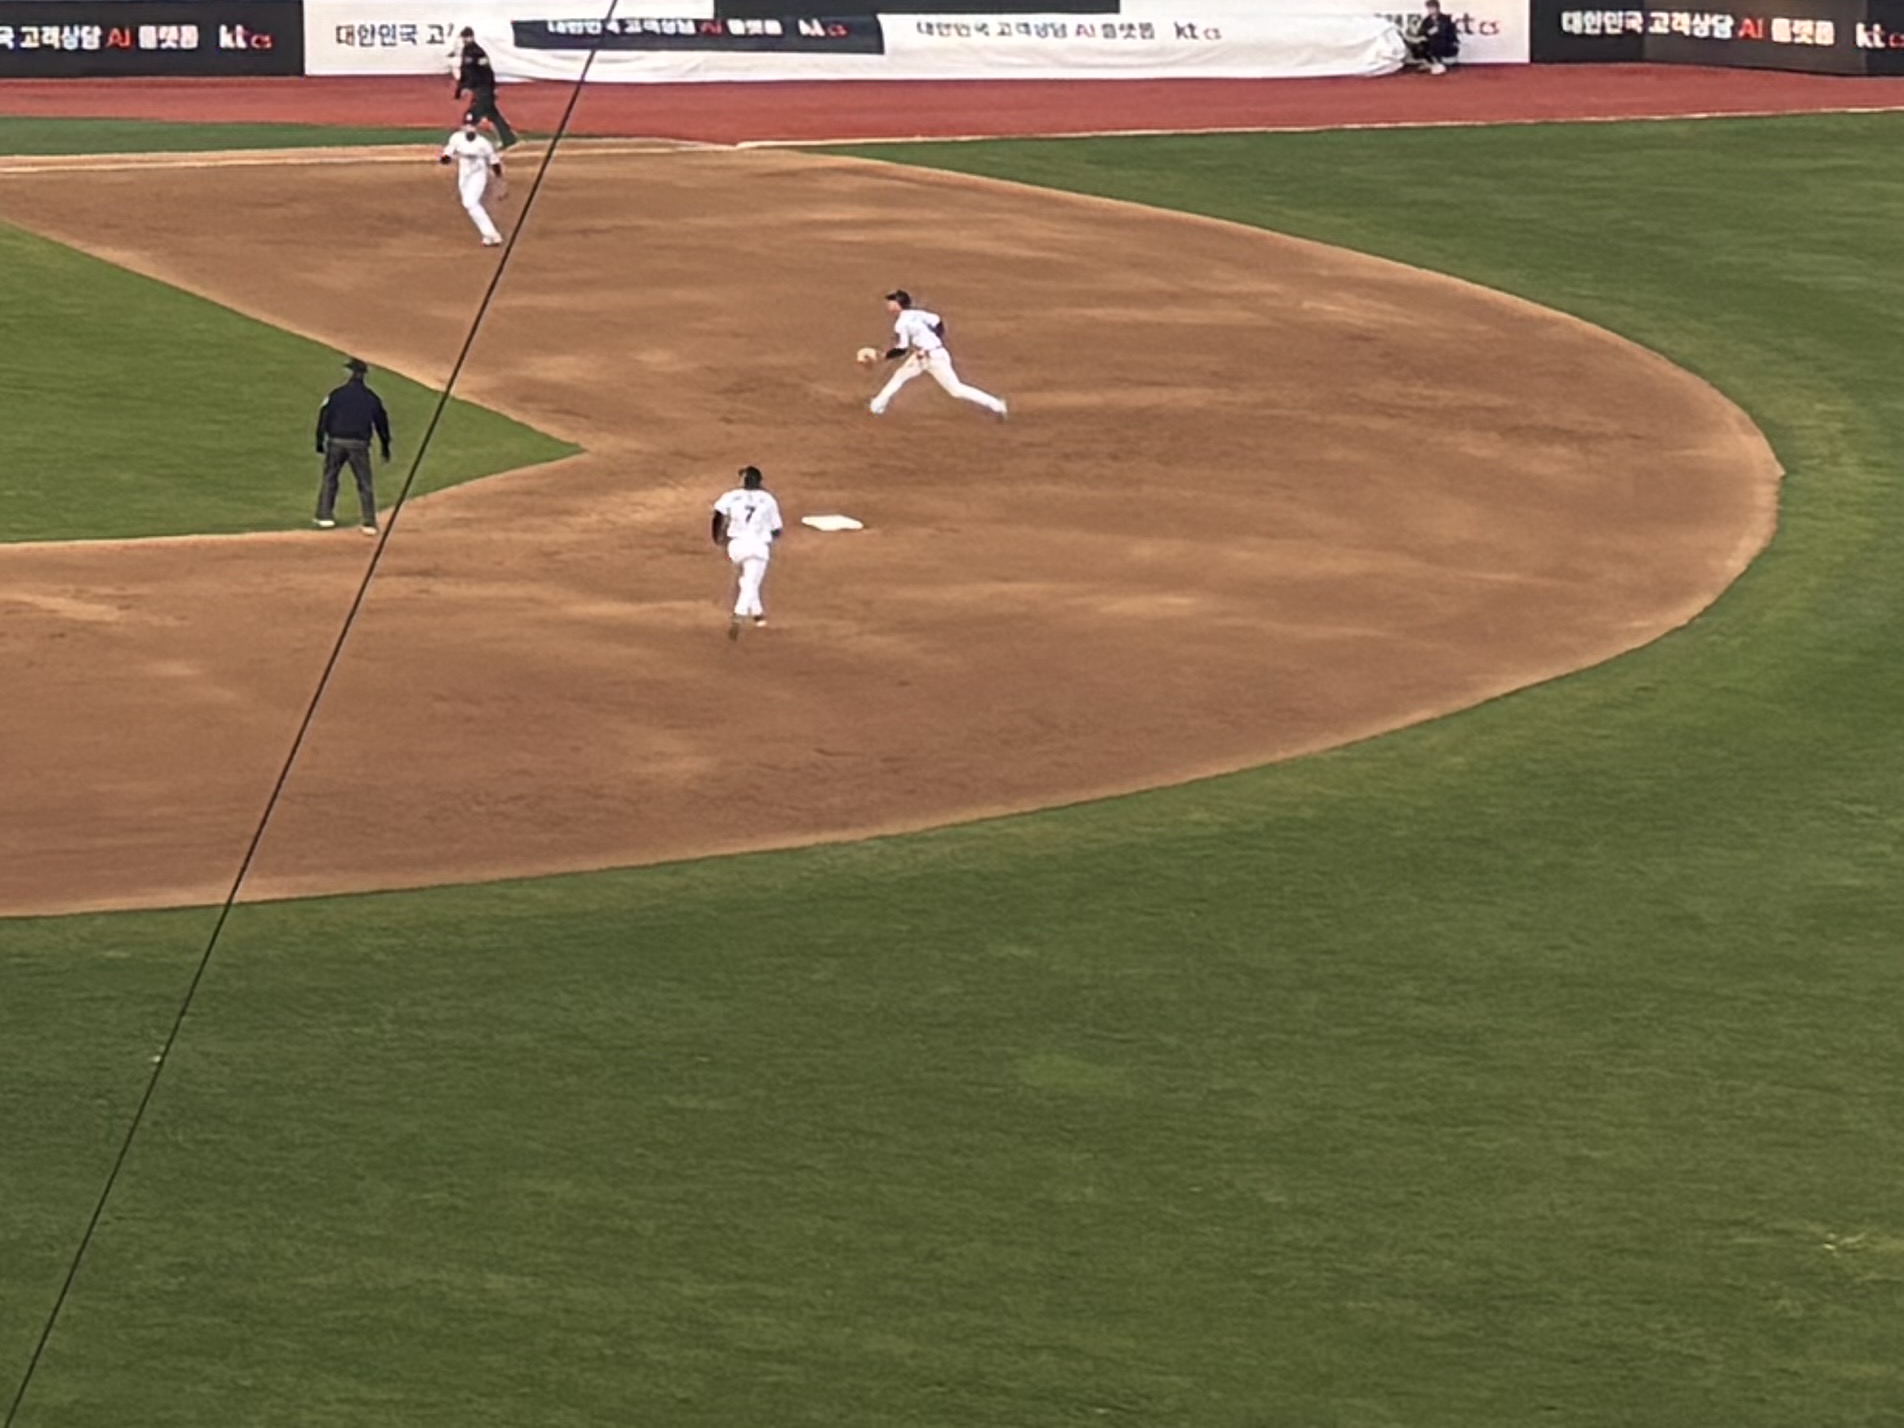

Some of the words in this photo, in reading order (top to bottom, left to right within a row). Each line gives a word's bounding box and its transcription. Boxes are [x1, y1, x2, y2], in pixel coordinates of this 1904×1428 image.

[19, 24, 102, 51] 고객상담
[106, 28, 132, 50] AI
[219, 24, 247, 50] kt
[335, 24, 419, 46] 대한민국
[1174, 21, 1199, 41] kt
[1561, 10, 1643, 34] 대한민국
[1648, 11, 1733, 39] 고객상담
[1738, 18, 1763, 39] AI
[1855, 22, 1886, 48] kt
